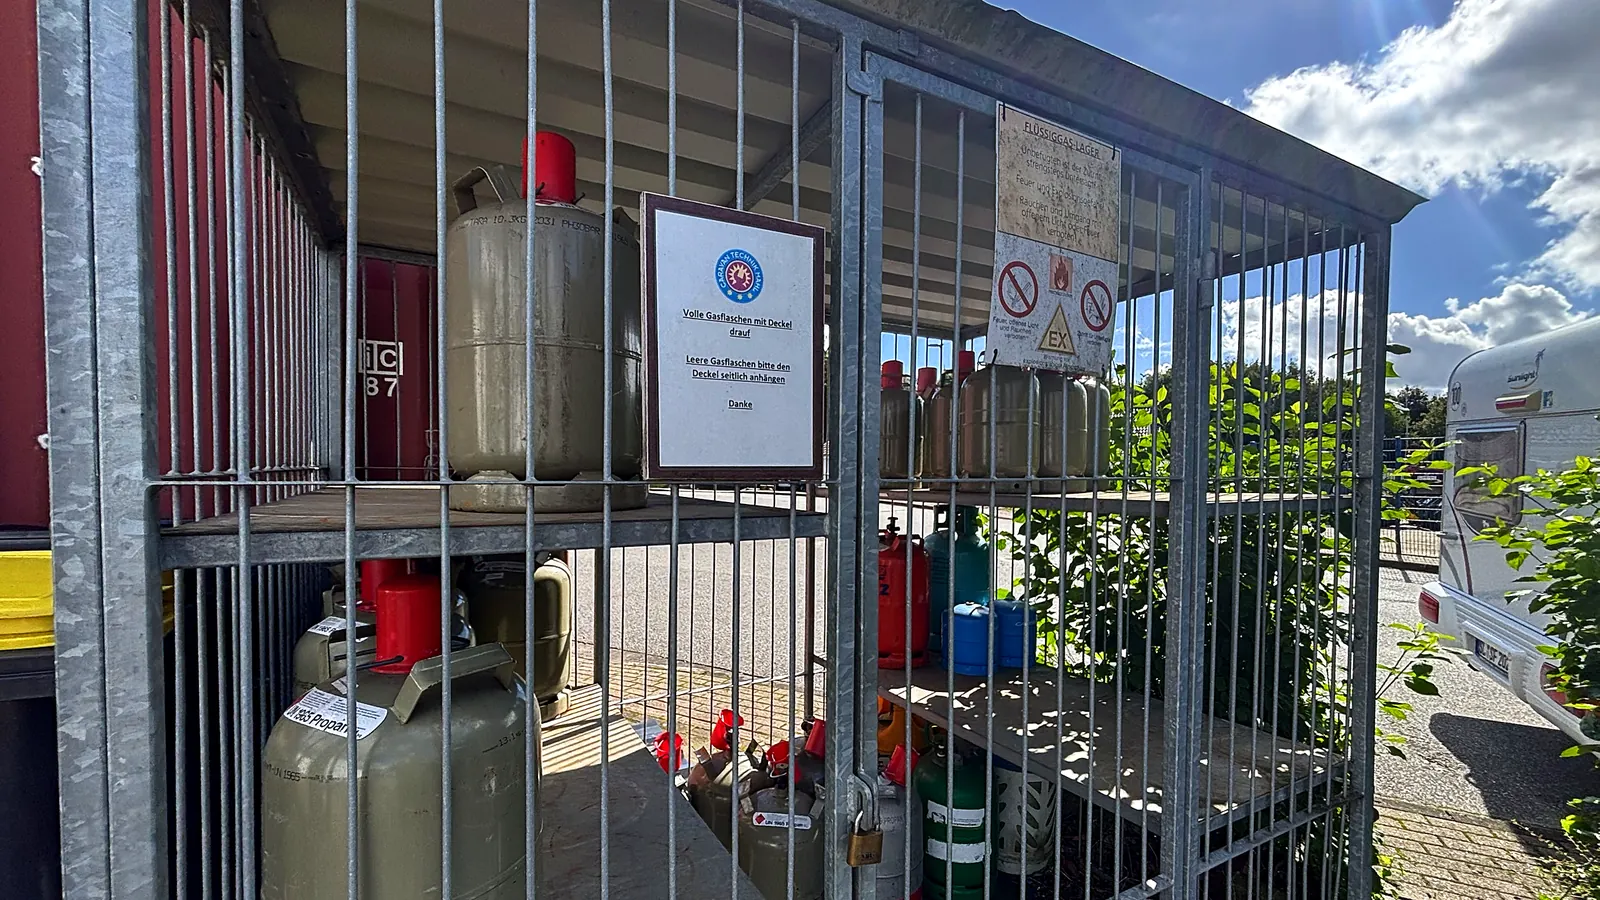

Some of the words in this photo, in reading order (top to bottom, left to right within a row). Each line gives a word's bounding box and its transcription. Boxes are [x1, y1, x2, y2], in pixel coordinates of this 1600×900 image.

[717, 254, 731, 288] CARAVAN
[730, 251, 760, 271] TECHNIK
[682, 308, 704, 319] Volle
[705, 311, 752, 325] Gasflaschen
[753, 317, 767, 327] mit
[768, 318, 793, 330] Deckel
[729, 327, 751, 338] drauf
[1048, 330, 1068, 349] EX
[686, 355, 709, 366] Leere
[710, 356, 757, 370] Gasflaschen
[757, 361, 776, 371] bitte
[776, 362, 791, 372] den
[692, 369, 719, 379] Deckel
[720, 371, 749, 382] seitlich
[749, 373, 786, 384] anhängen
[366, 377, 398, 397] 87
[728, 400, 753, 410] Danke
[283, 769, 301, 782] 1965
